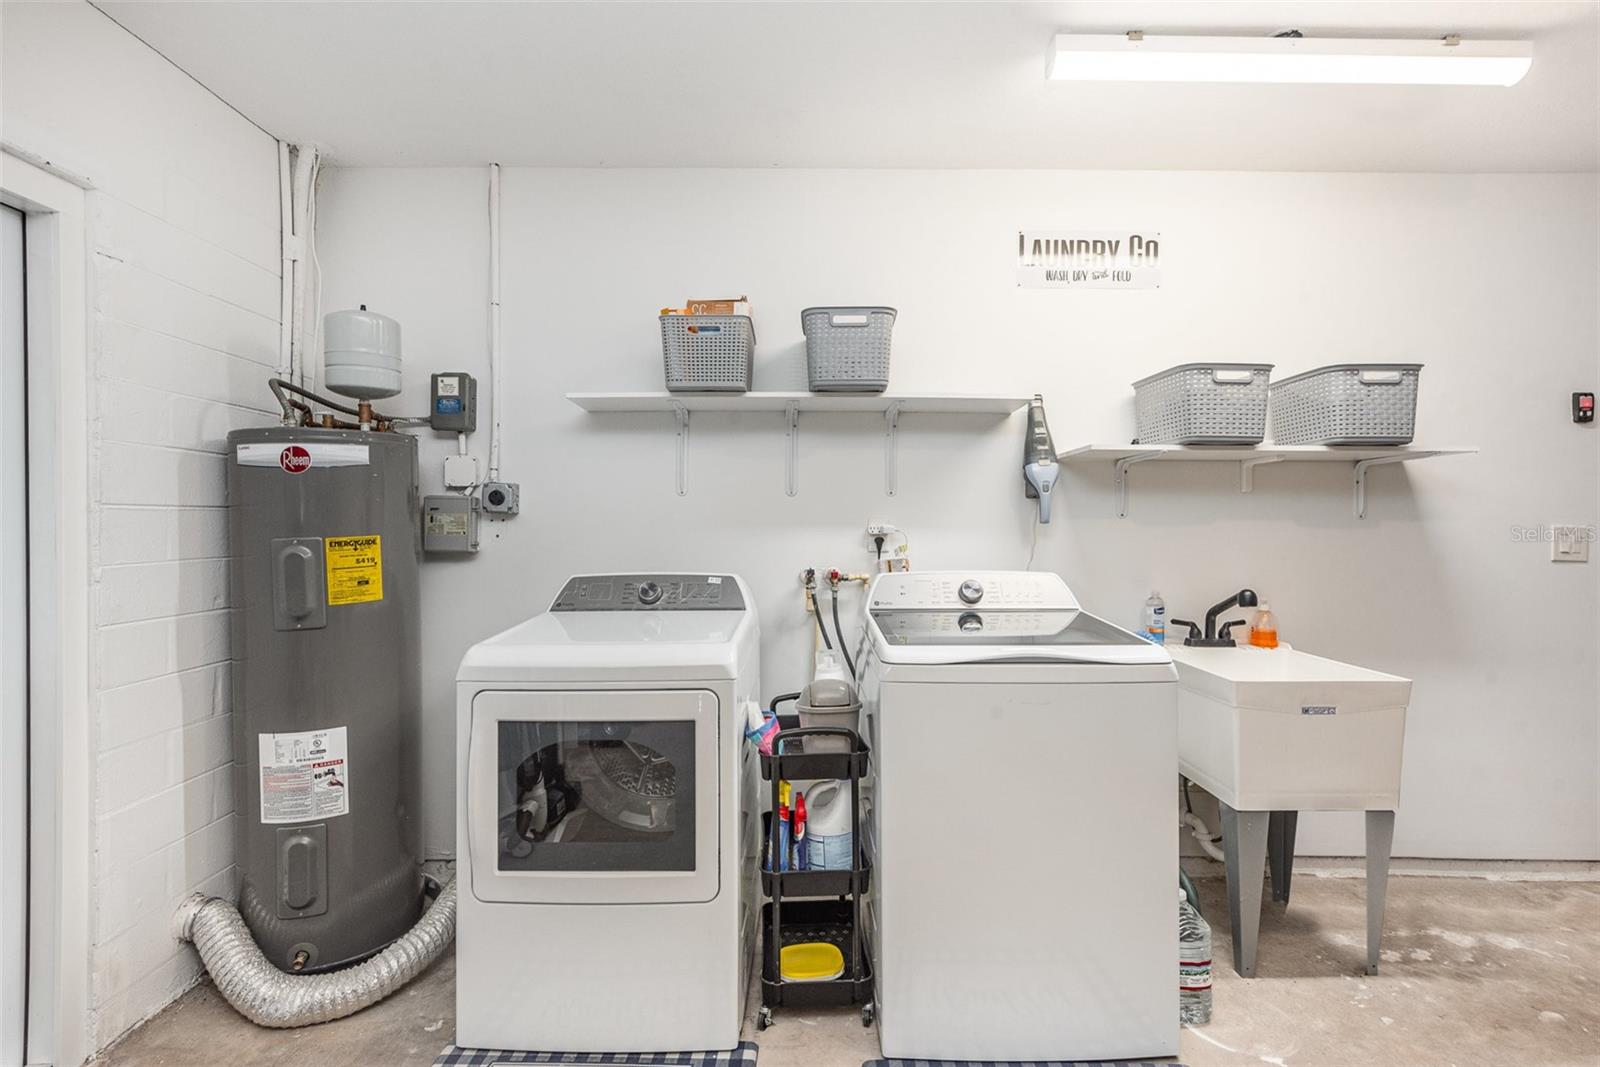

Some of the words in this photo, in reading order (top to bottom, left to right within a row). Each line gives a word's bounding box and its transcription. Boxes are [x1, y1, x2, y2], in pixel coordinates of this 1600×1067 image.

[1045, 270, 1070, 284] WASH,
[1072, 270, 1088, 282] DRY
[1091, 268, 1109, 280] and
[1112, 270, 1132, 282] FOLD
[282, 447, 310, 470] Rheem
